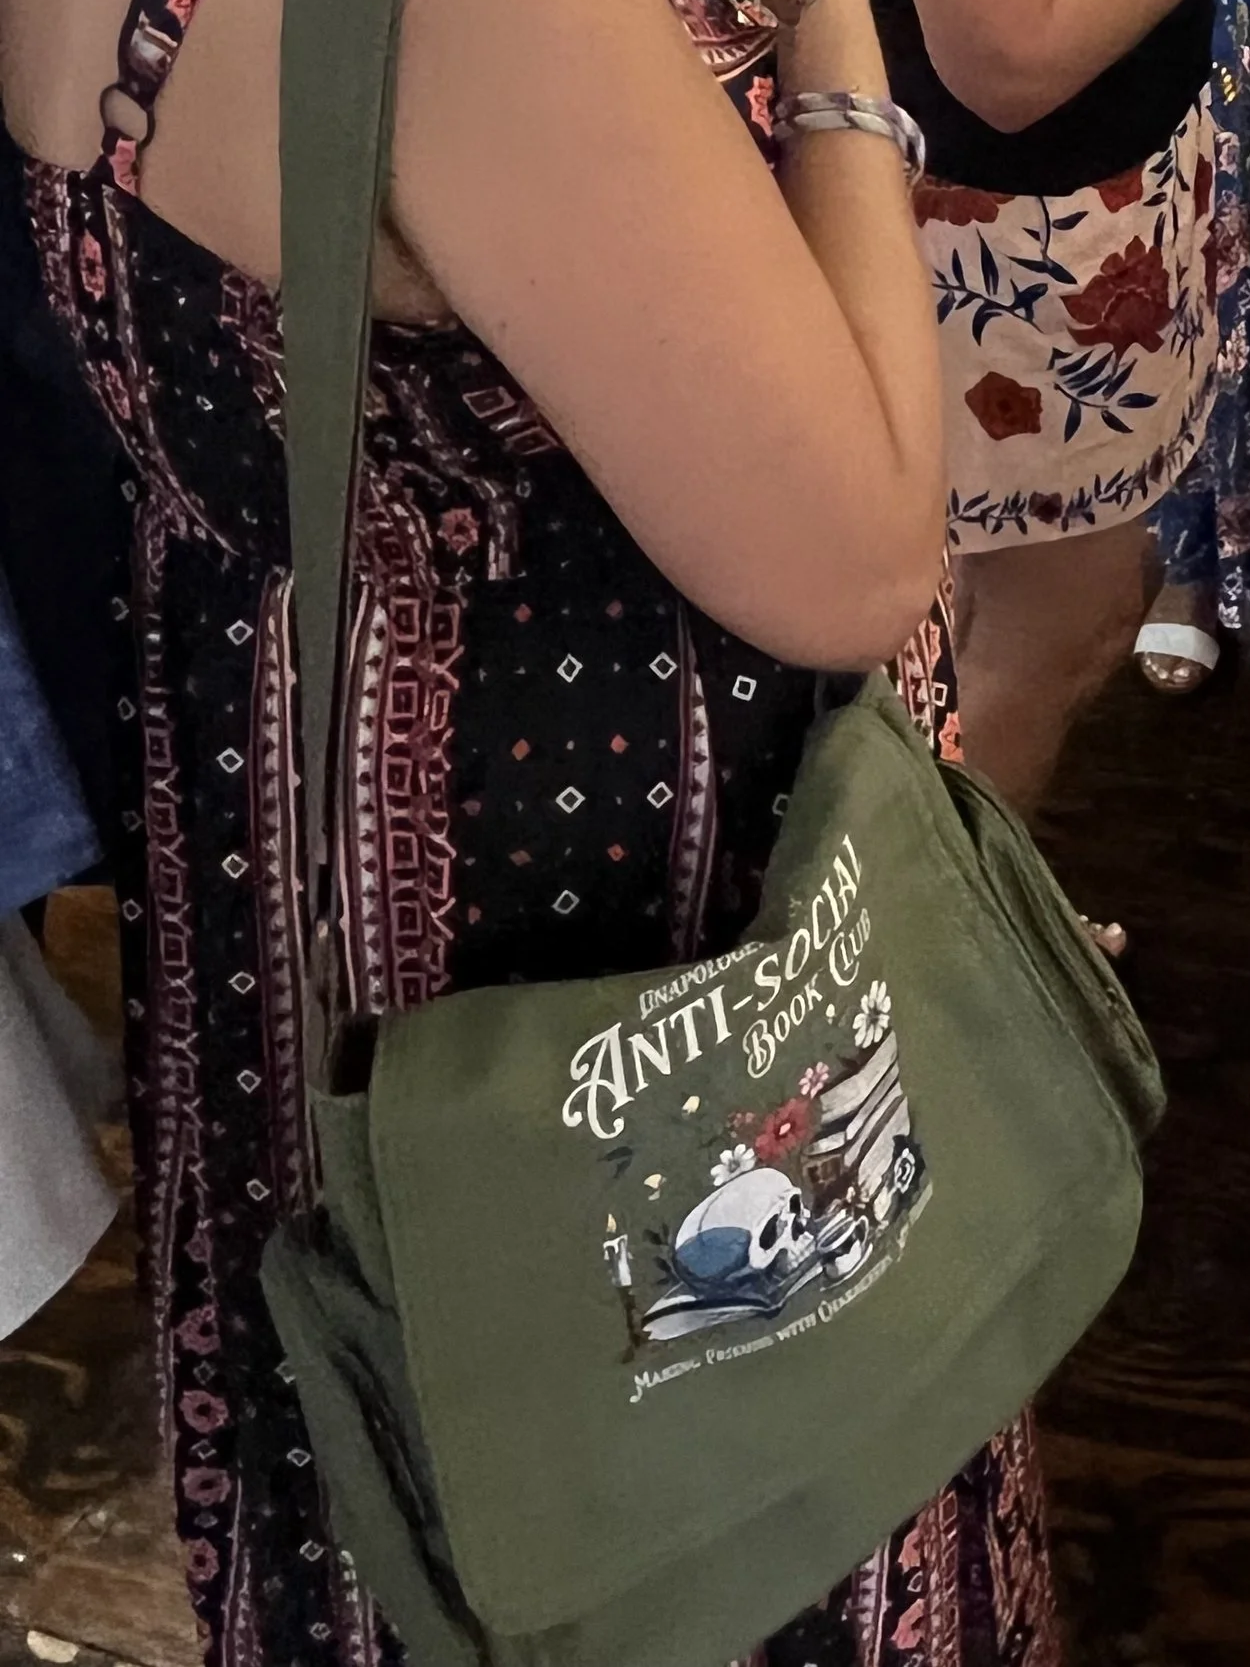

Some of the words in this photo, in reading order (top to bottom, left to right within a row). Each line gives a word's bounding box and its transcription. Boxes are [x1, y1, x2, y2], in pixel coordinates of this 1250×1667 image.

[561, 833, 863, 1140] ANTI-SOCIAL
[742, 966, 825, 1080] BOOK
[828, 907, 872, 987] CLUB
